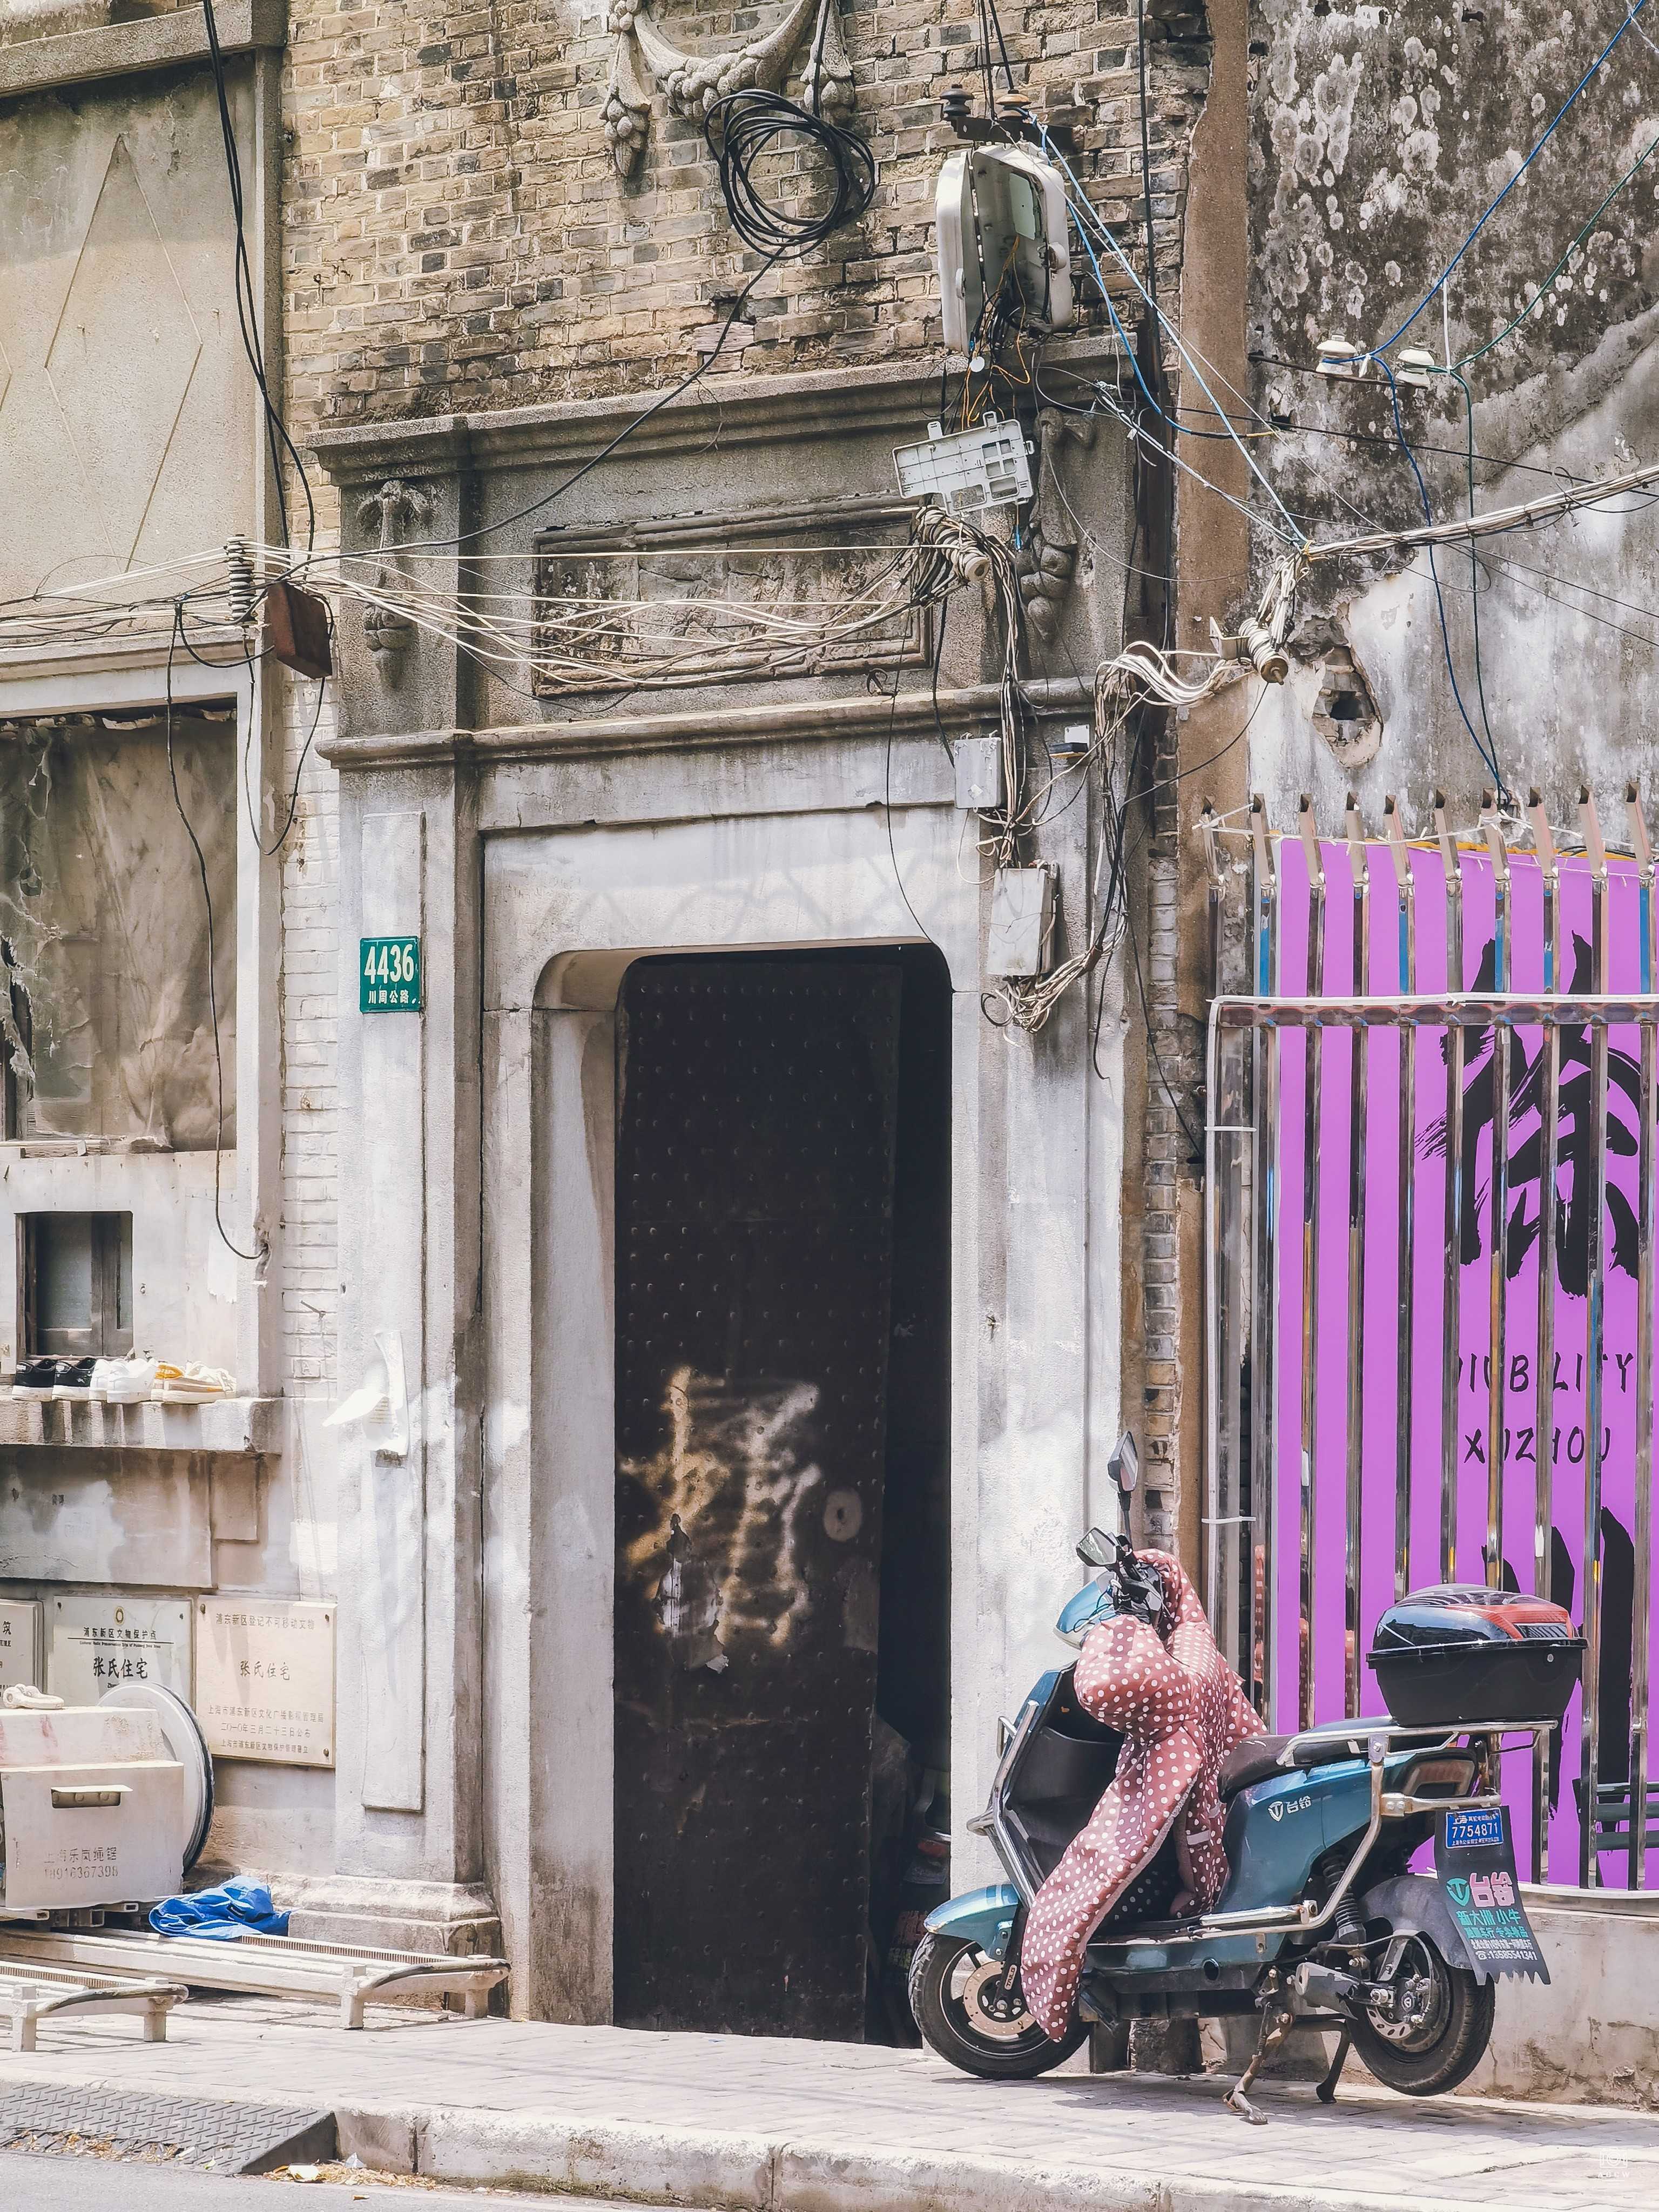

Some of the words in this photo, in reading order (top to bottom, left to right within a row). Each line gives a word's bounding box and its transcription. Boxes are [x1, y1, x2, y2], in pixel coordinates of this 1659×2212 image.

[364, 944, 414, 984] 4436
[1458, 1351, 1634, 1393] IBLIY
[93, 1656, 148, 1679] 张氏住宅
[240, 1660, 290, 1681] 张氏住宅
[1452, 1822, 1498, 1838] 7754871
[1495, 1908, 1521, 1925] 小牛
